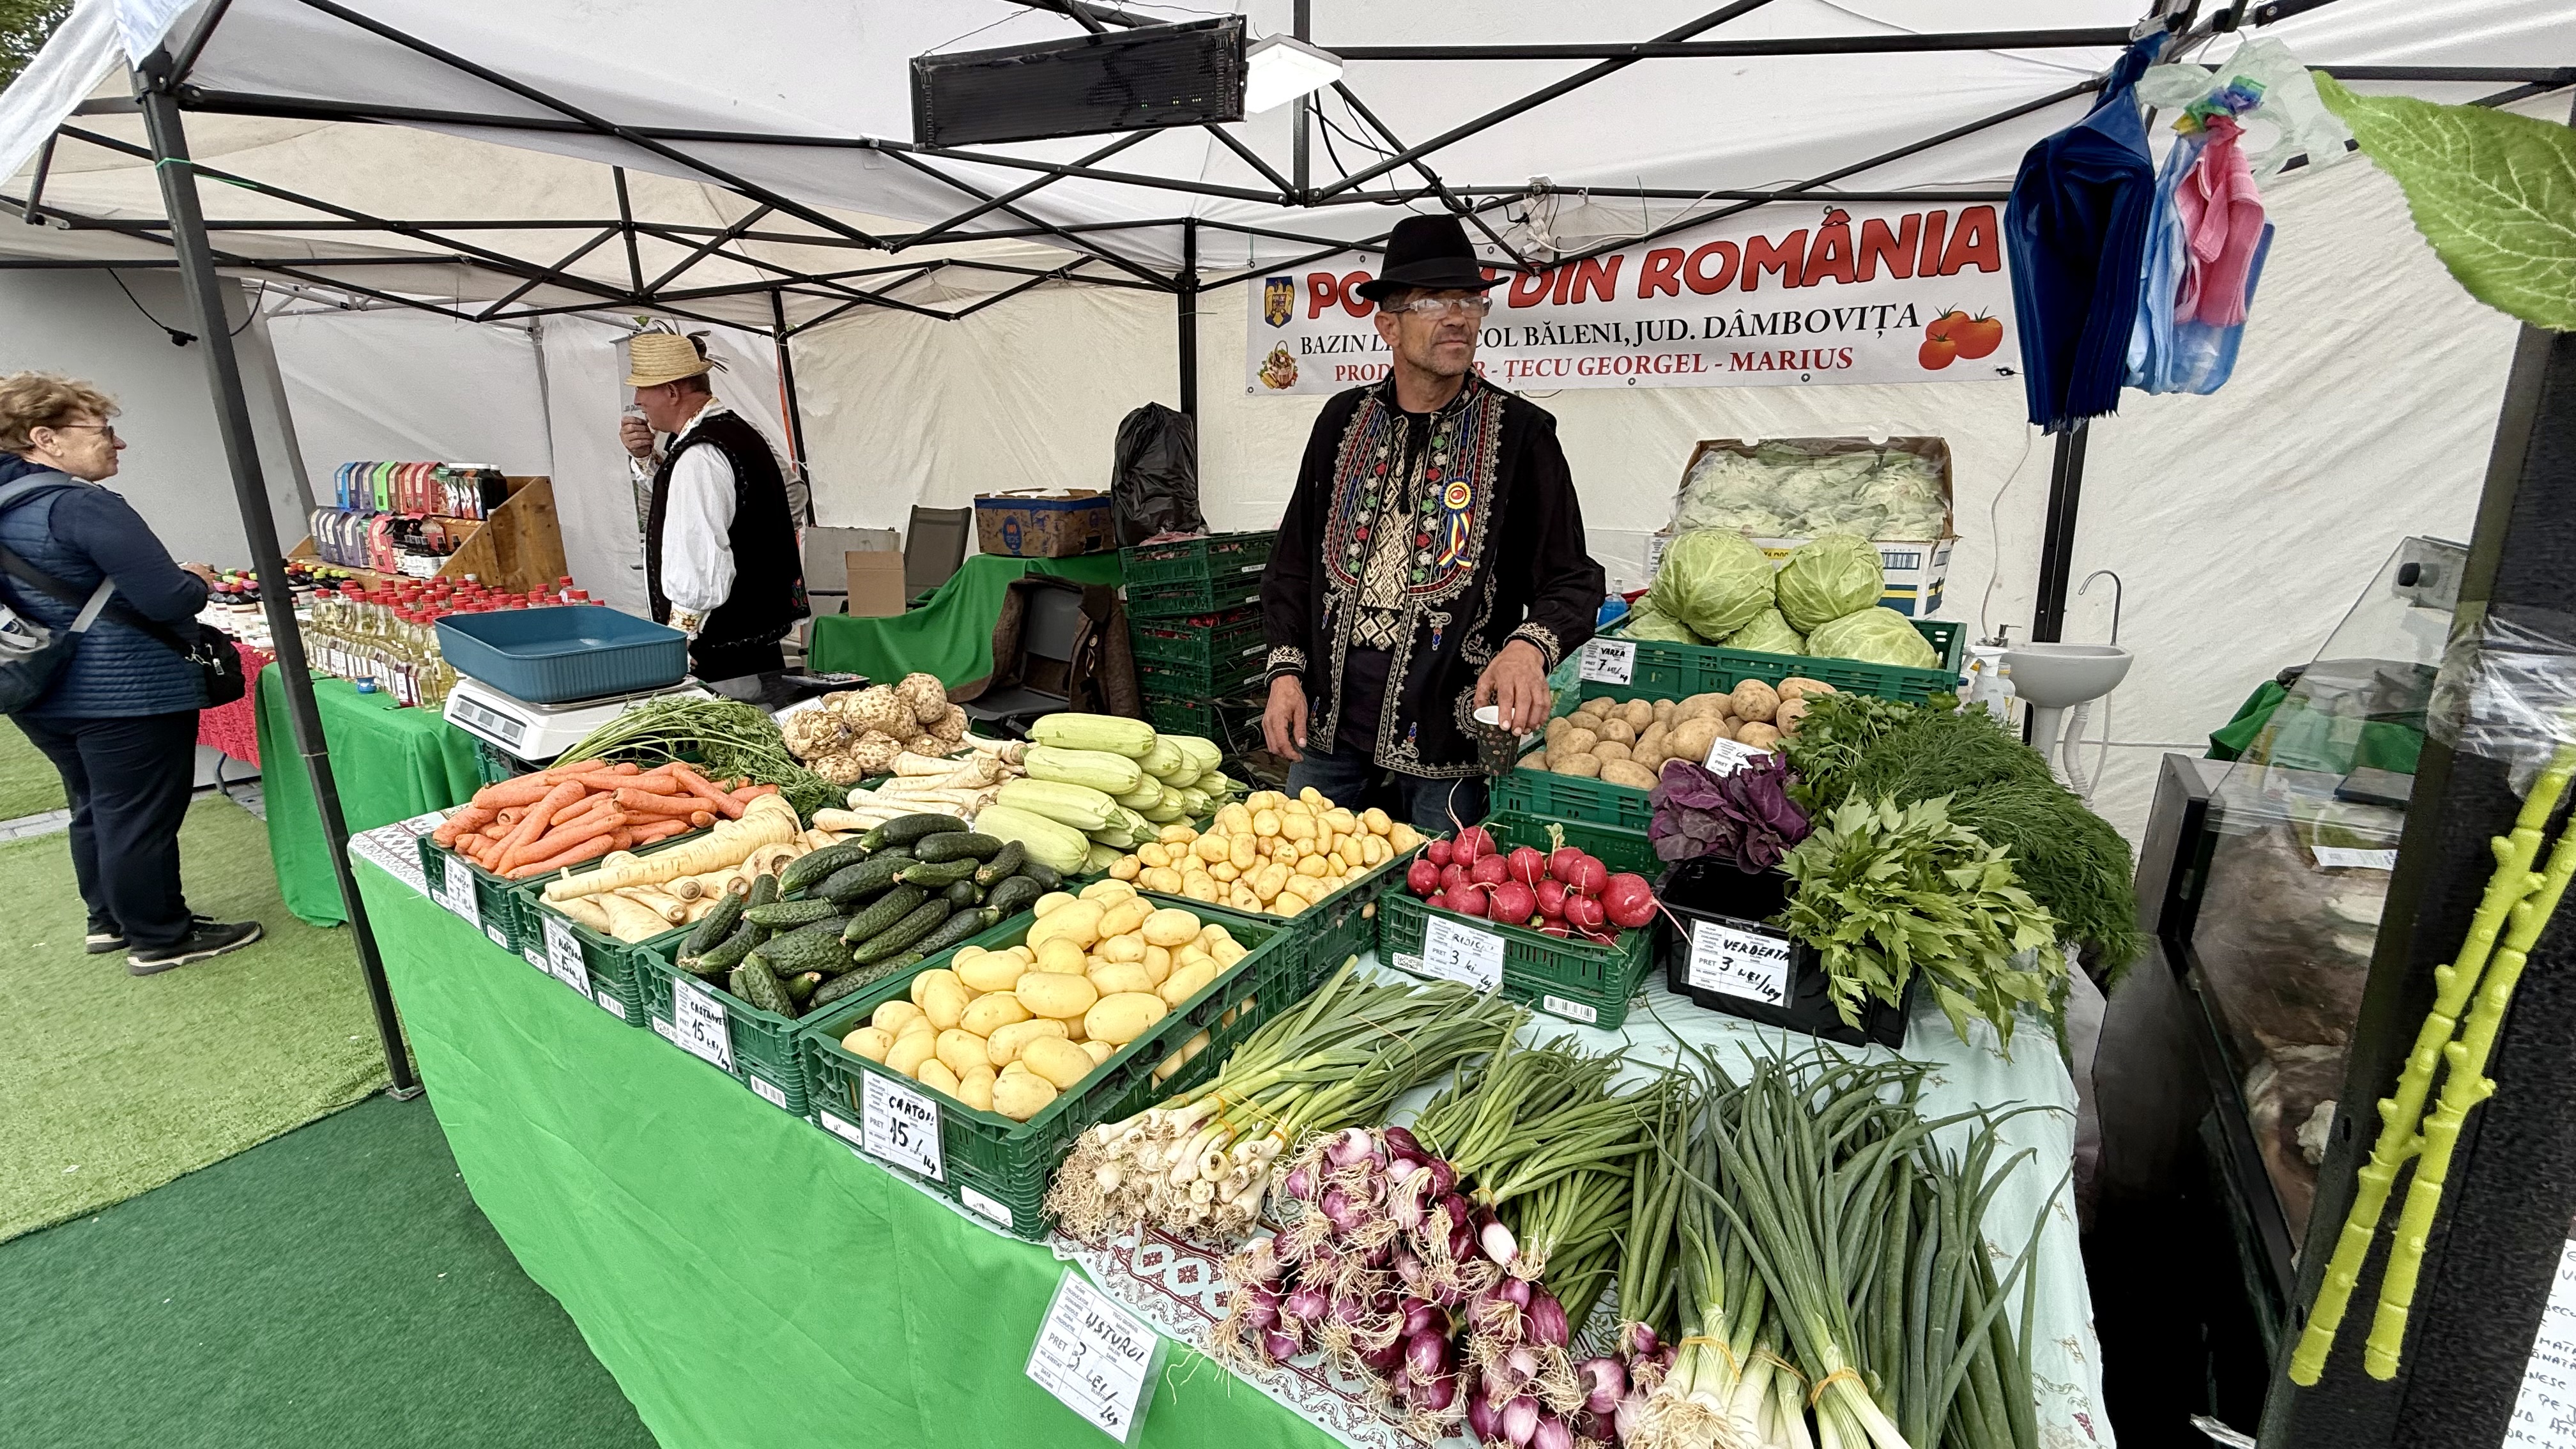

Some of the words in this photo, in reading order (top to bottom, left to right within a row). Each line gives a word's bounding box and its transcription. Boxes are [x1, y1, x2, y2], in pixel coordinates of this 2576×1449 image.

[1508, 254, 1624, 309] DIN
[1637, 206, 2001, 299] ROMÂNIA
[1300, 334, 1368, 355] BAZIN
[1703, 302, 1921, 340] DÂMBOVIȚA
[1504, 358, 1573, 383] ȚECU
[1577, 353, 1708, 376] GEORGEL
[1728, 347, 1853, 372] MARIUS
[1597, 659, 1607, 670] 7
[1450, 949, 1459, 965] 3
[1698, 958, 1717, 967] PRET
[1719, 956, 1734, 971] 3
[692, 1018, 704, 1041] 15
[870, 1116, 883, 1129] PRET
[890, 1117, 908, 1147] 15
[1048, 1333, 1068, 1351] PRET
